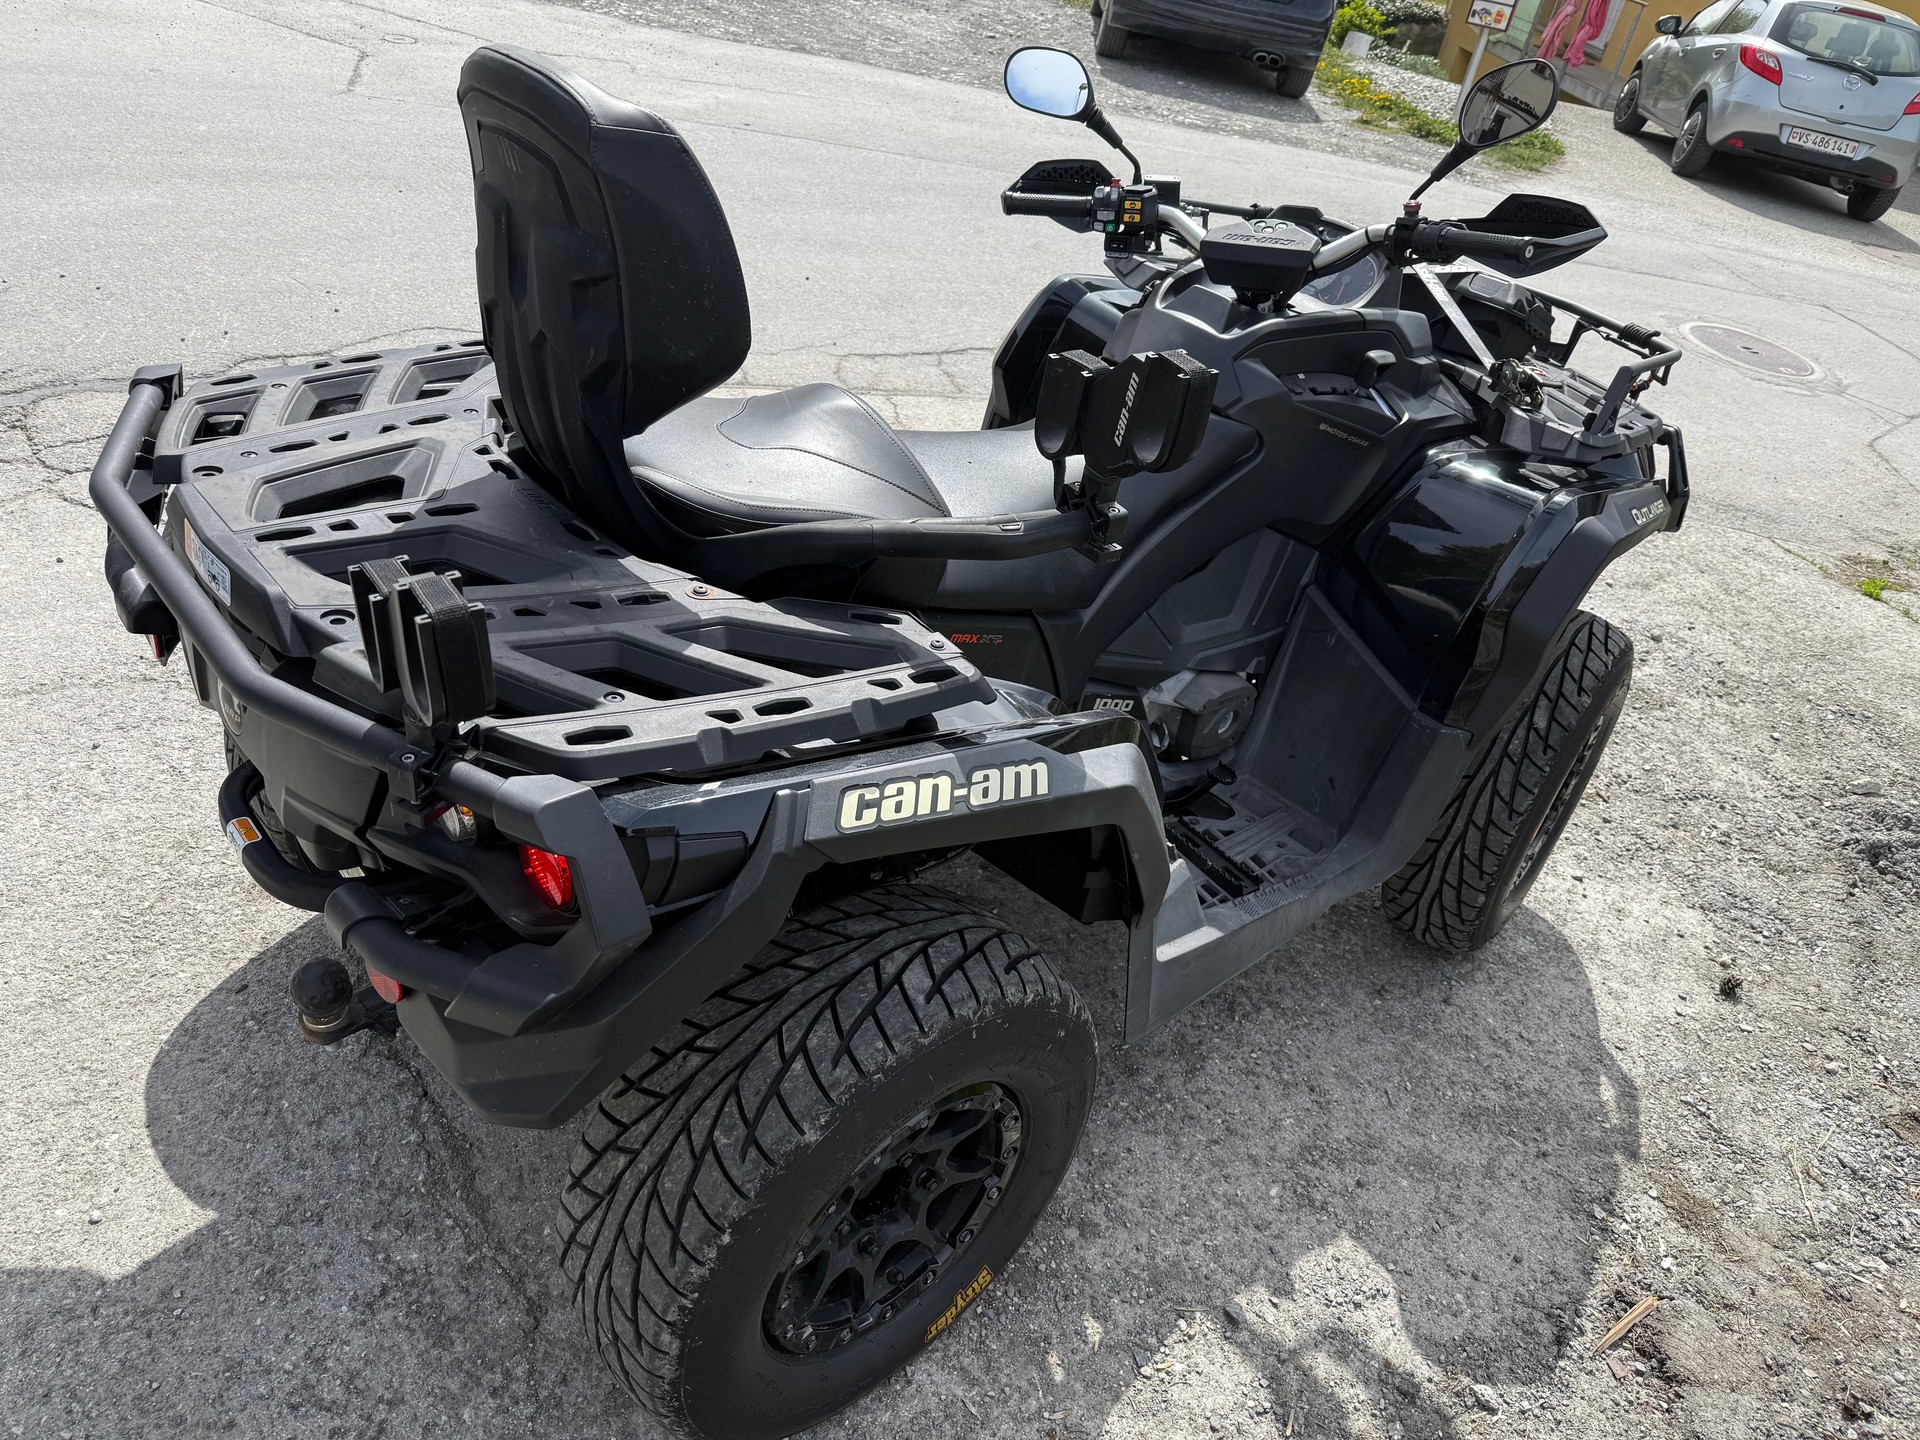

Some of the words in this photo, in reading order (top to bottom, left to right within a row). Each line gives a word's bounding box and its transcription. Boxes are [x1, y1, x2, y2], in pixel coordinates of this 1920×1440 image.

[1113, 371, 1140, 448] can-am
[1325, 424, 1370, 447] MOTOS-OSKAR
[950, 633, 980, 644] MAX
[1093, 697, 1134, 712] 1000
[839, 761, 1049, 829] can-am
[926, 1265, 993, 1341] Stryder
